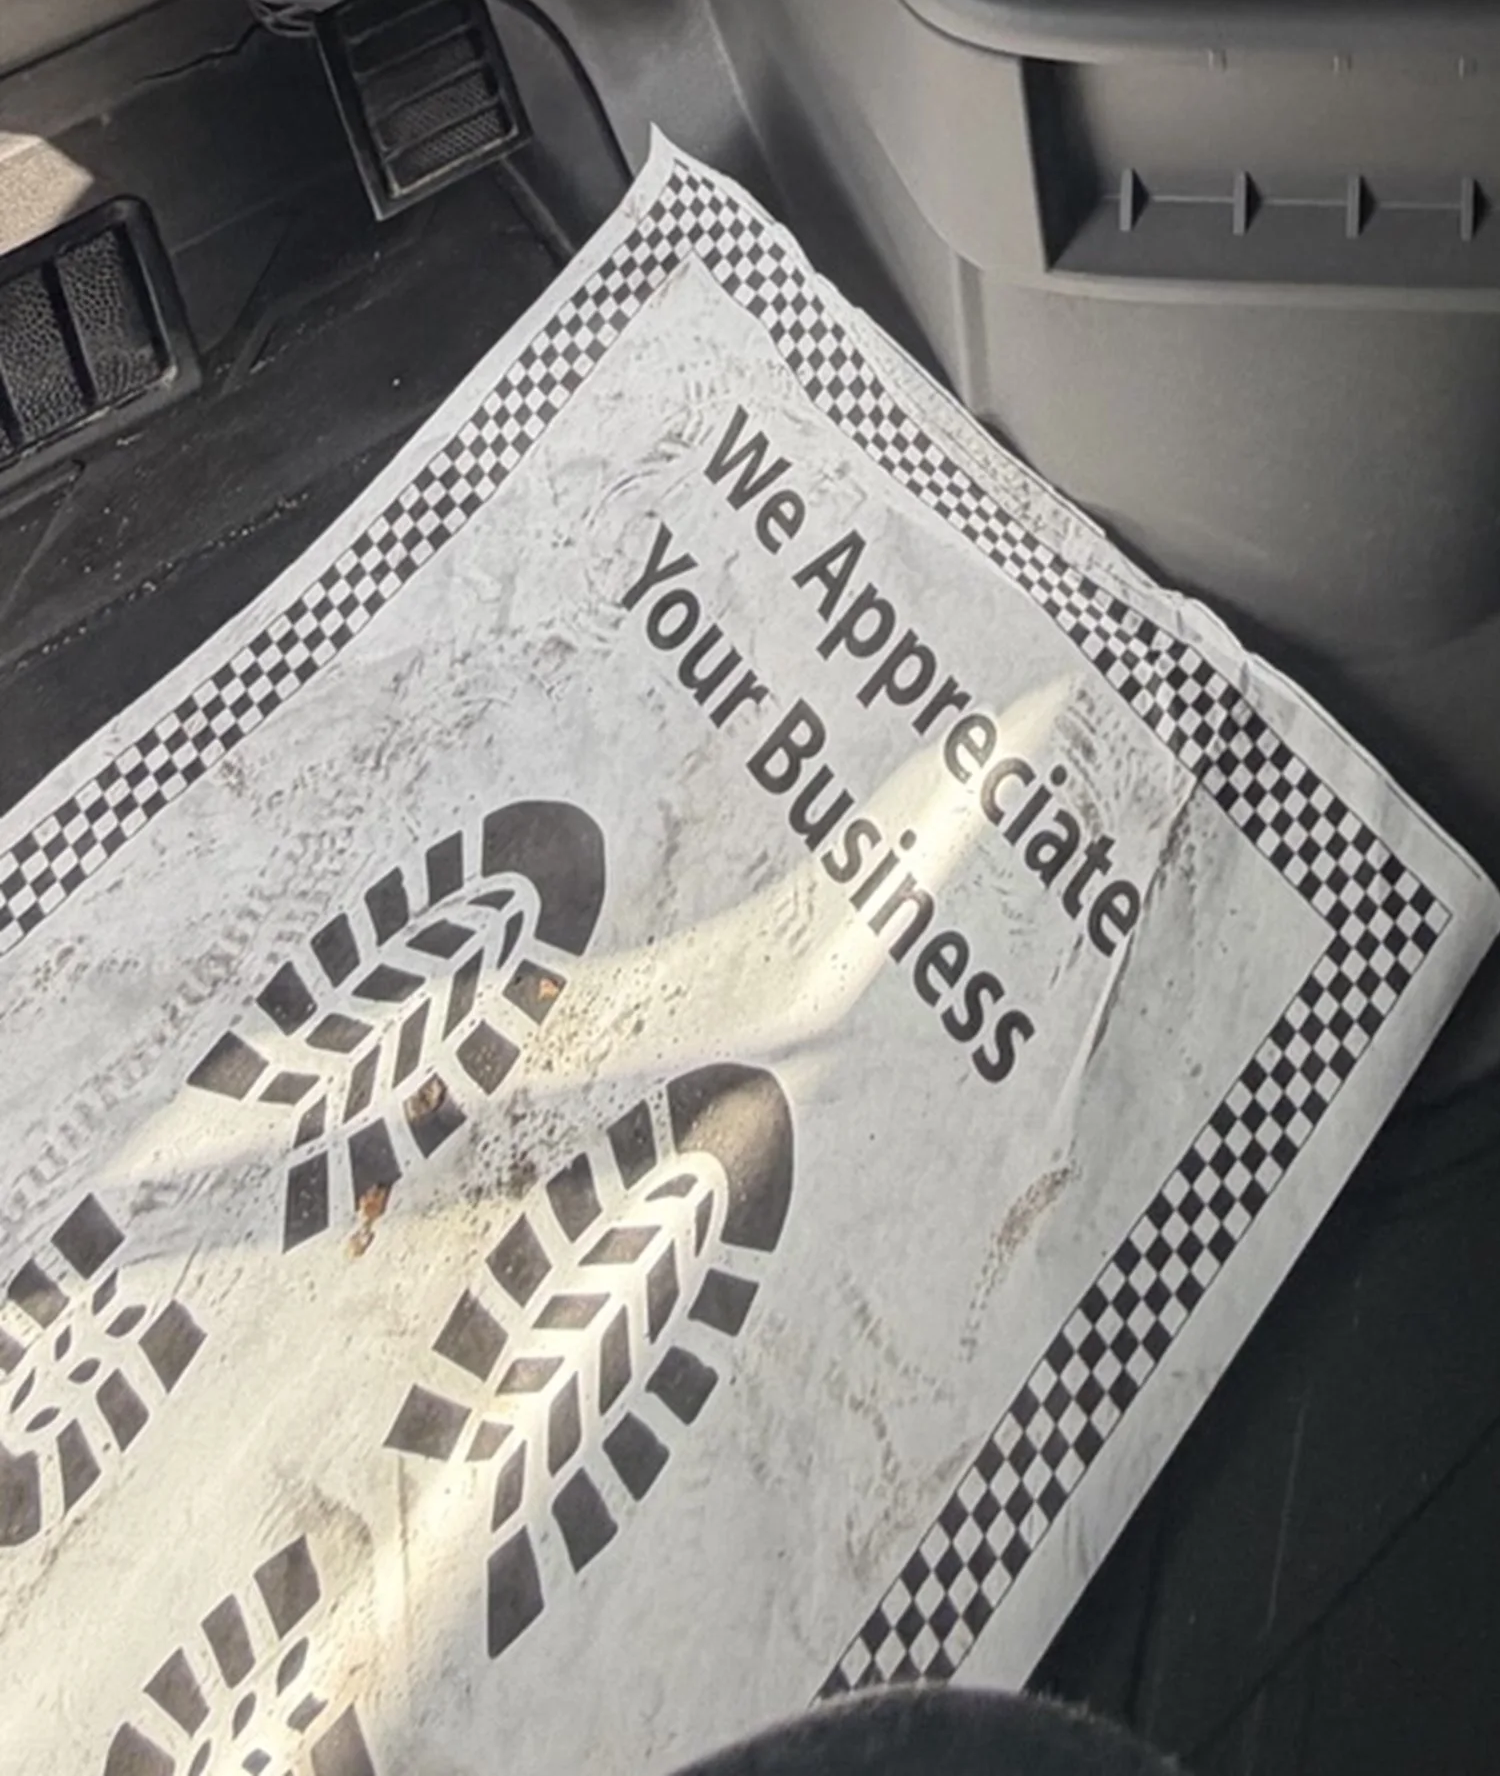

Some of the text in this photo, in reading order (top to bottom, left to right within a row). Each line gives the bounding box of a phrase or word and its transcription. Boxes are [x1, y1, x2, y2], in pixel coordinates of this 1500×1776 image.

[620, 522, 1037, 1084] Your Business
[702, 404, 1143, 958] We Appreciate
